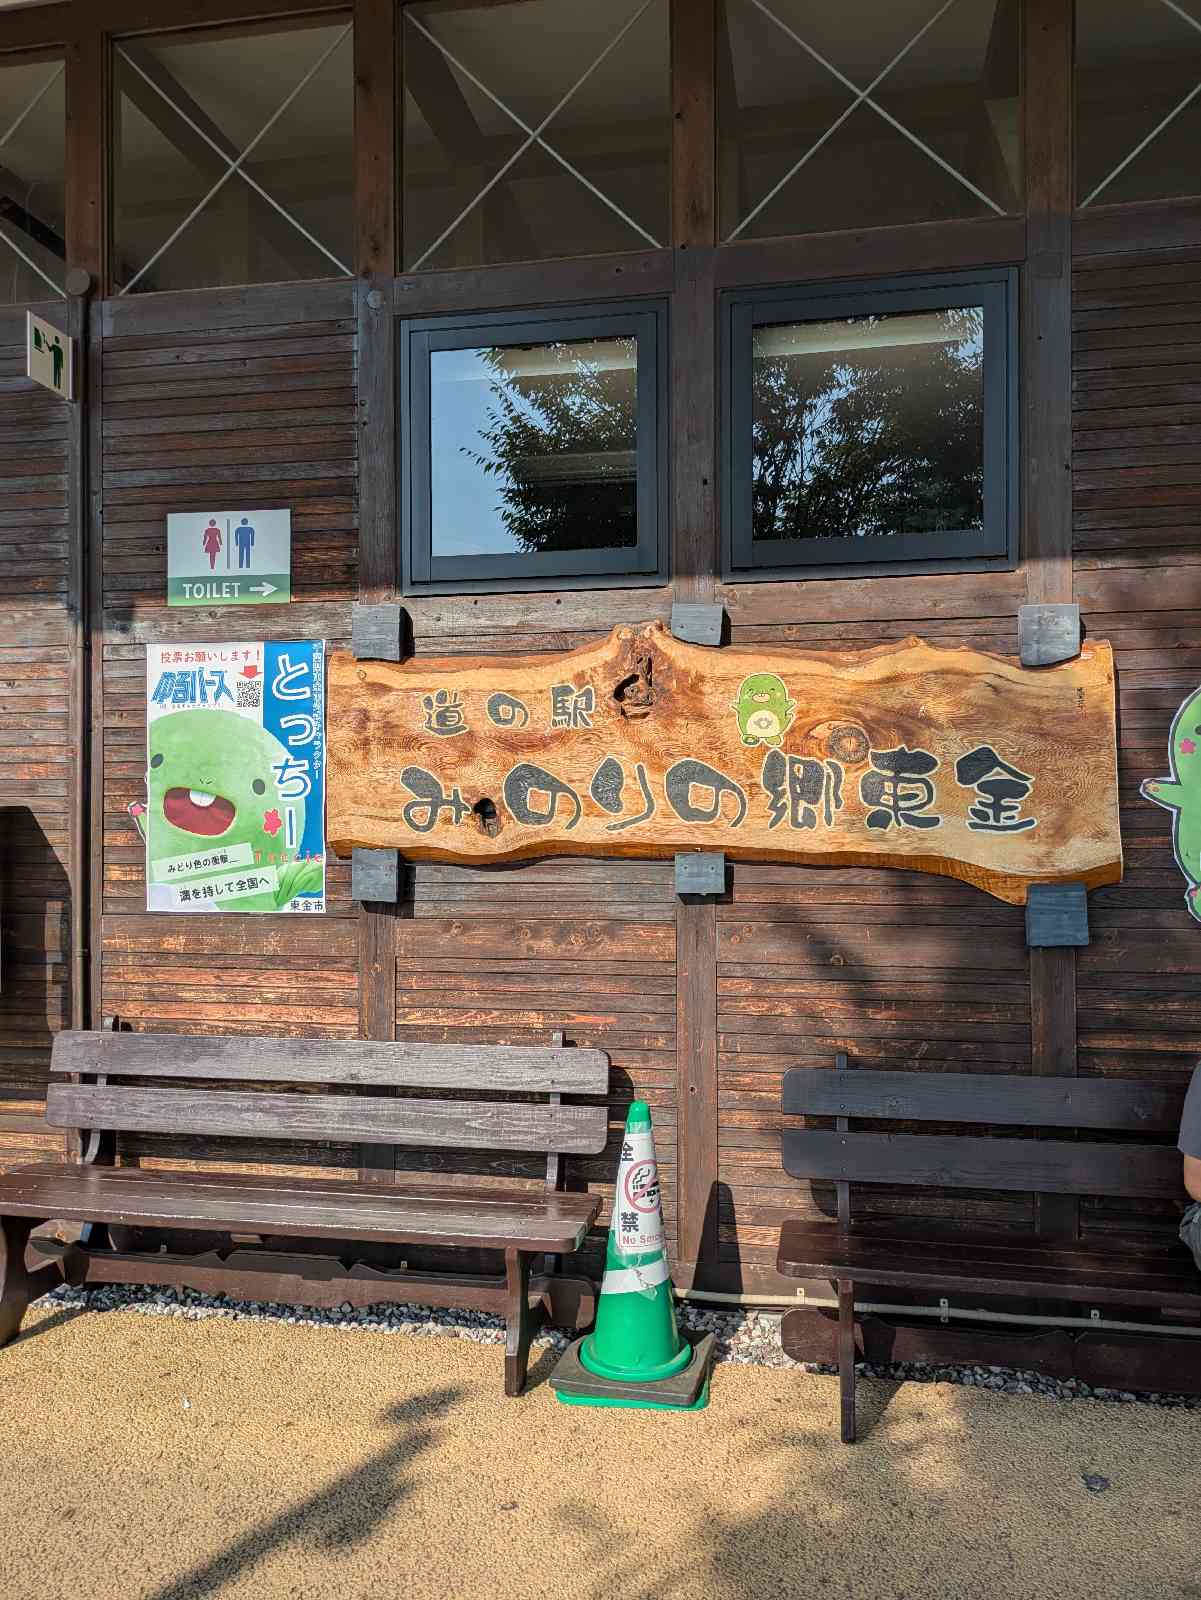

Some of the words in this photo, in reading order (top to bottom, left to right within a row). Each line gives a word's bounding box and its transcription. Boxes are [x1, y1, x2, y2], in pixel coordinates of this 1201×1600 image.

[182, 583, 241, 599] TOILET
[421, 683, 596, 738] 道の駅
[290, 901, 324, 911] 東金市
[622, 1235, 636, 1245] No
